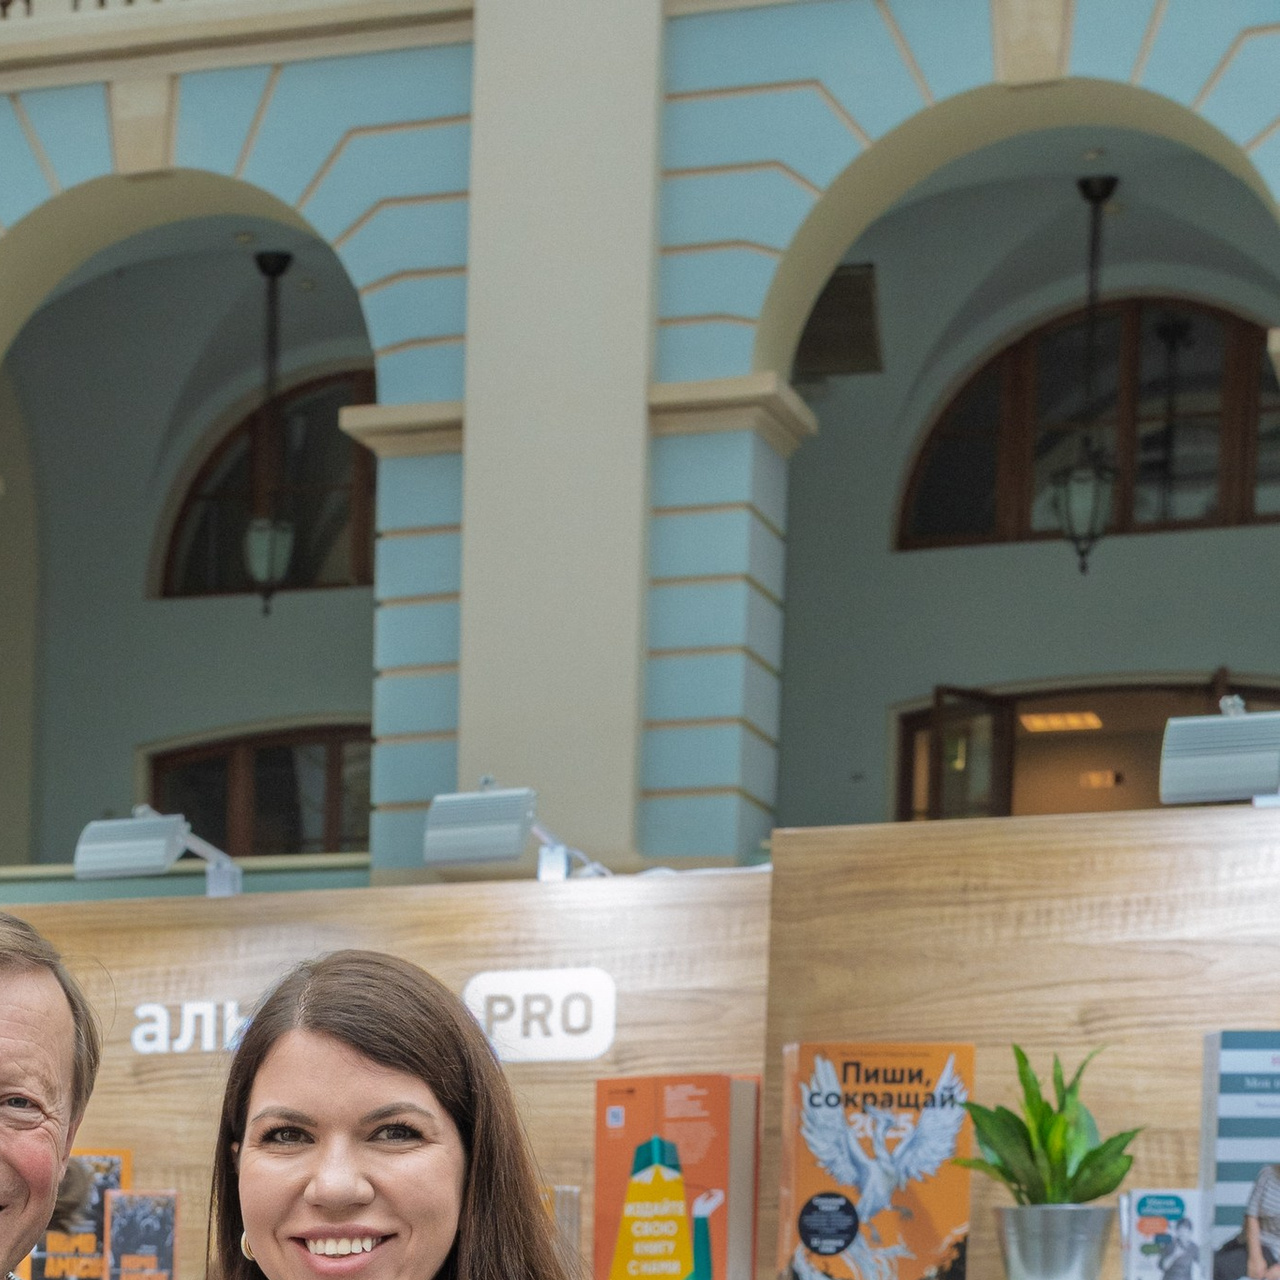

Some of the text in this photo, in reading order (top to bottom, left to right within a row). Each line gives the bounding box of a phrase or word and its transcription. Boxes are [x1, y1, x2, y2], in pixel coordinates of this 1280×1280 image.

[130, 1000, 252, 1055] аль
[483, 992, 594, 1038] PRO
[842, 1062, 931, 1087] Пиши,
[808, 1086, 956, 1114] сокращай
[631, 1220, 679, 1237] СВОЮ
